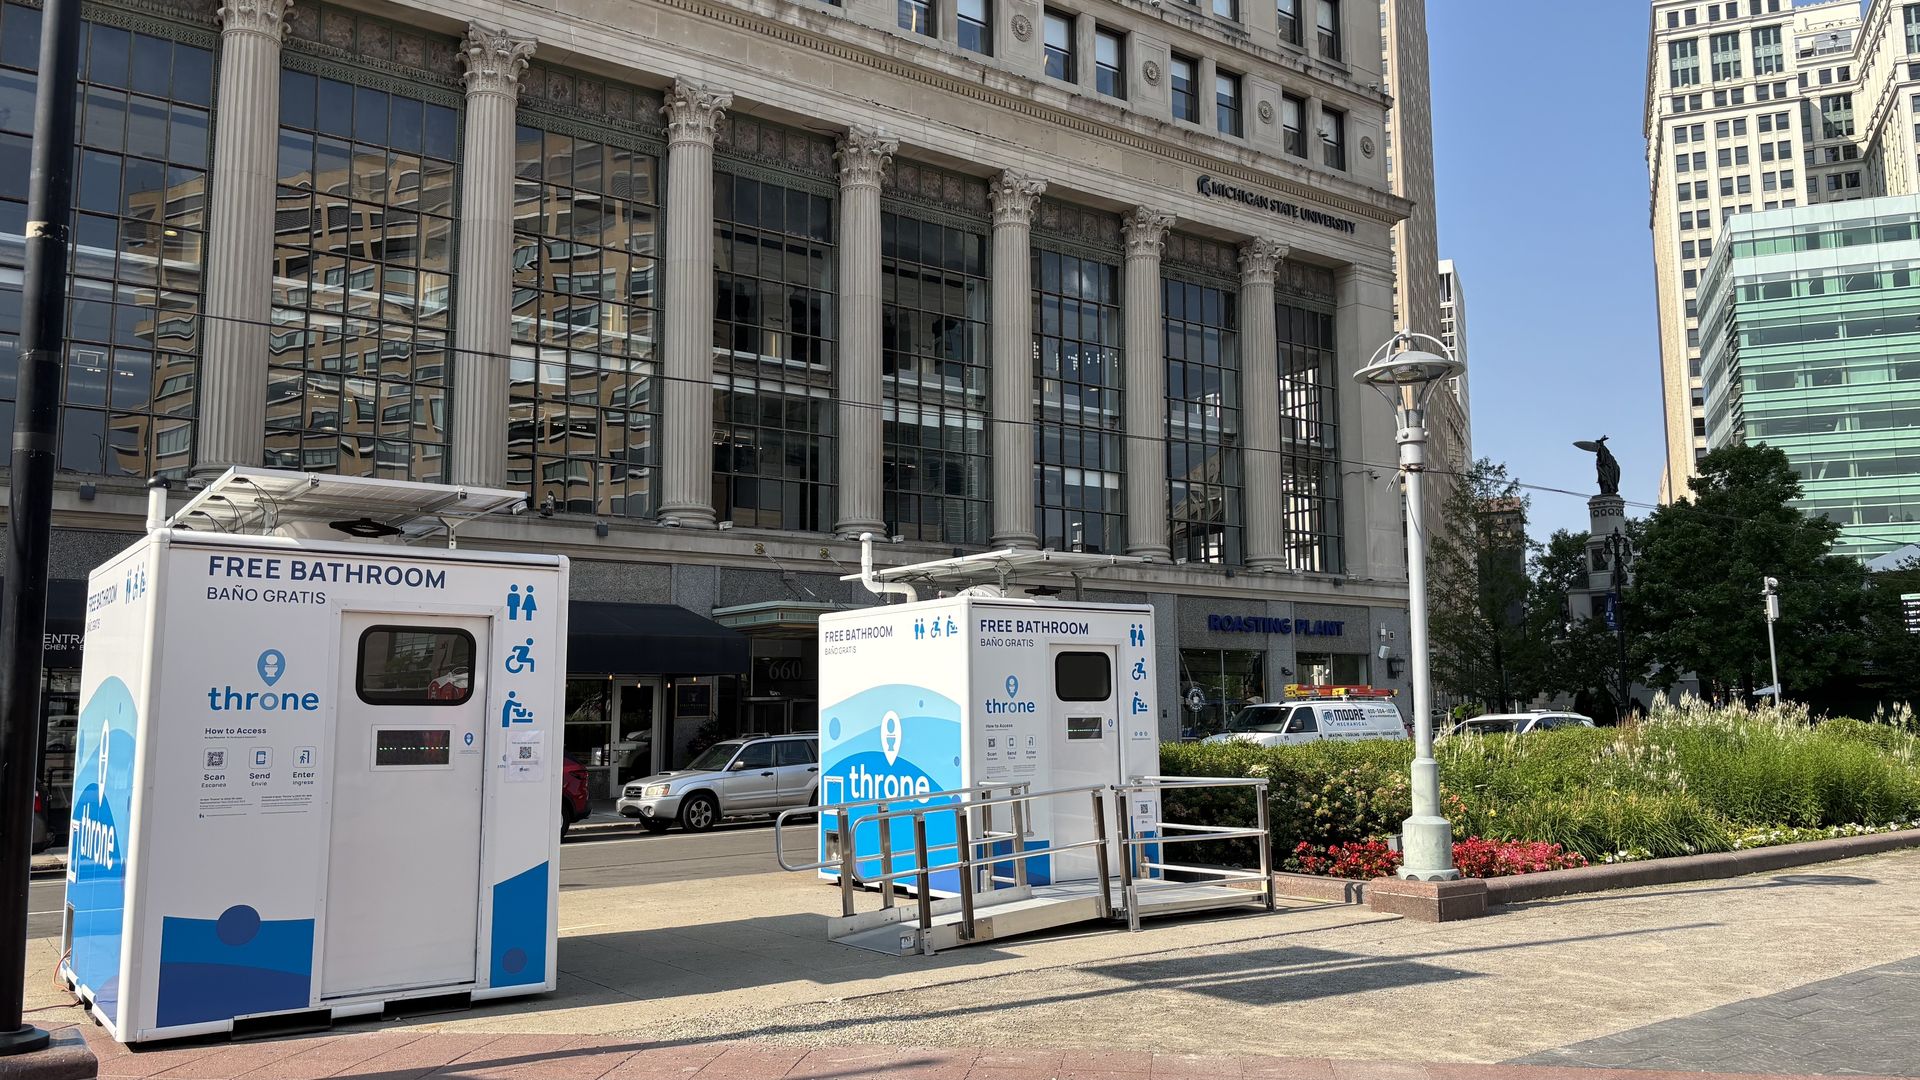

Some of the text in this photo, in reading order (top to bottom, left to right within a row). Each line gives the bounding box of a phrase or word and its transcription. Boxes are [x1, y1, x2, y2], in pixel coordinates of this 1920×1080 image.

[1211, 181, 1356, 234] MICHIGAN STATE UNIVERSITY
[208, 555, 446, 589] FREE BATHROOM
[207, 584, 326, 605] BAÑO GRATIS
[824, 625, 893, 643] FREE BATHROOM
[980, 619, 1089, 635] FREE BATHROOM
[1207, 614, 1345, 637] ROASTING PLANT
[980, 636, 1034, 648] BAÑO GRATIS
[768, 660, 802, 680] 660
[208, 686, 319, 711] throne
[985, 698, 1035, 714] throne
[1333, 708, 1366, 721] MOORE
[204, 727, 267, 735] How to Access
[203, 773, 226, 781] Scan
[292, 771, 315, 779] Enter
[848, 763, 930, 804] throne
[81, 802, 115, 870] throne
